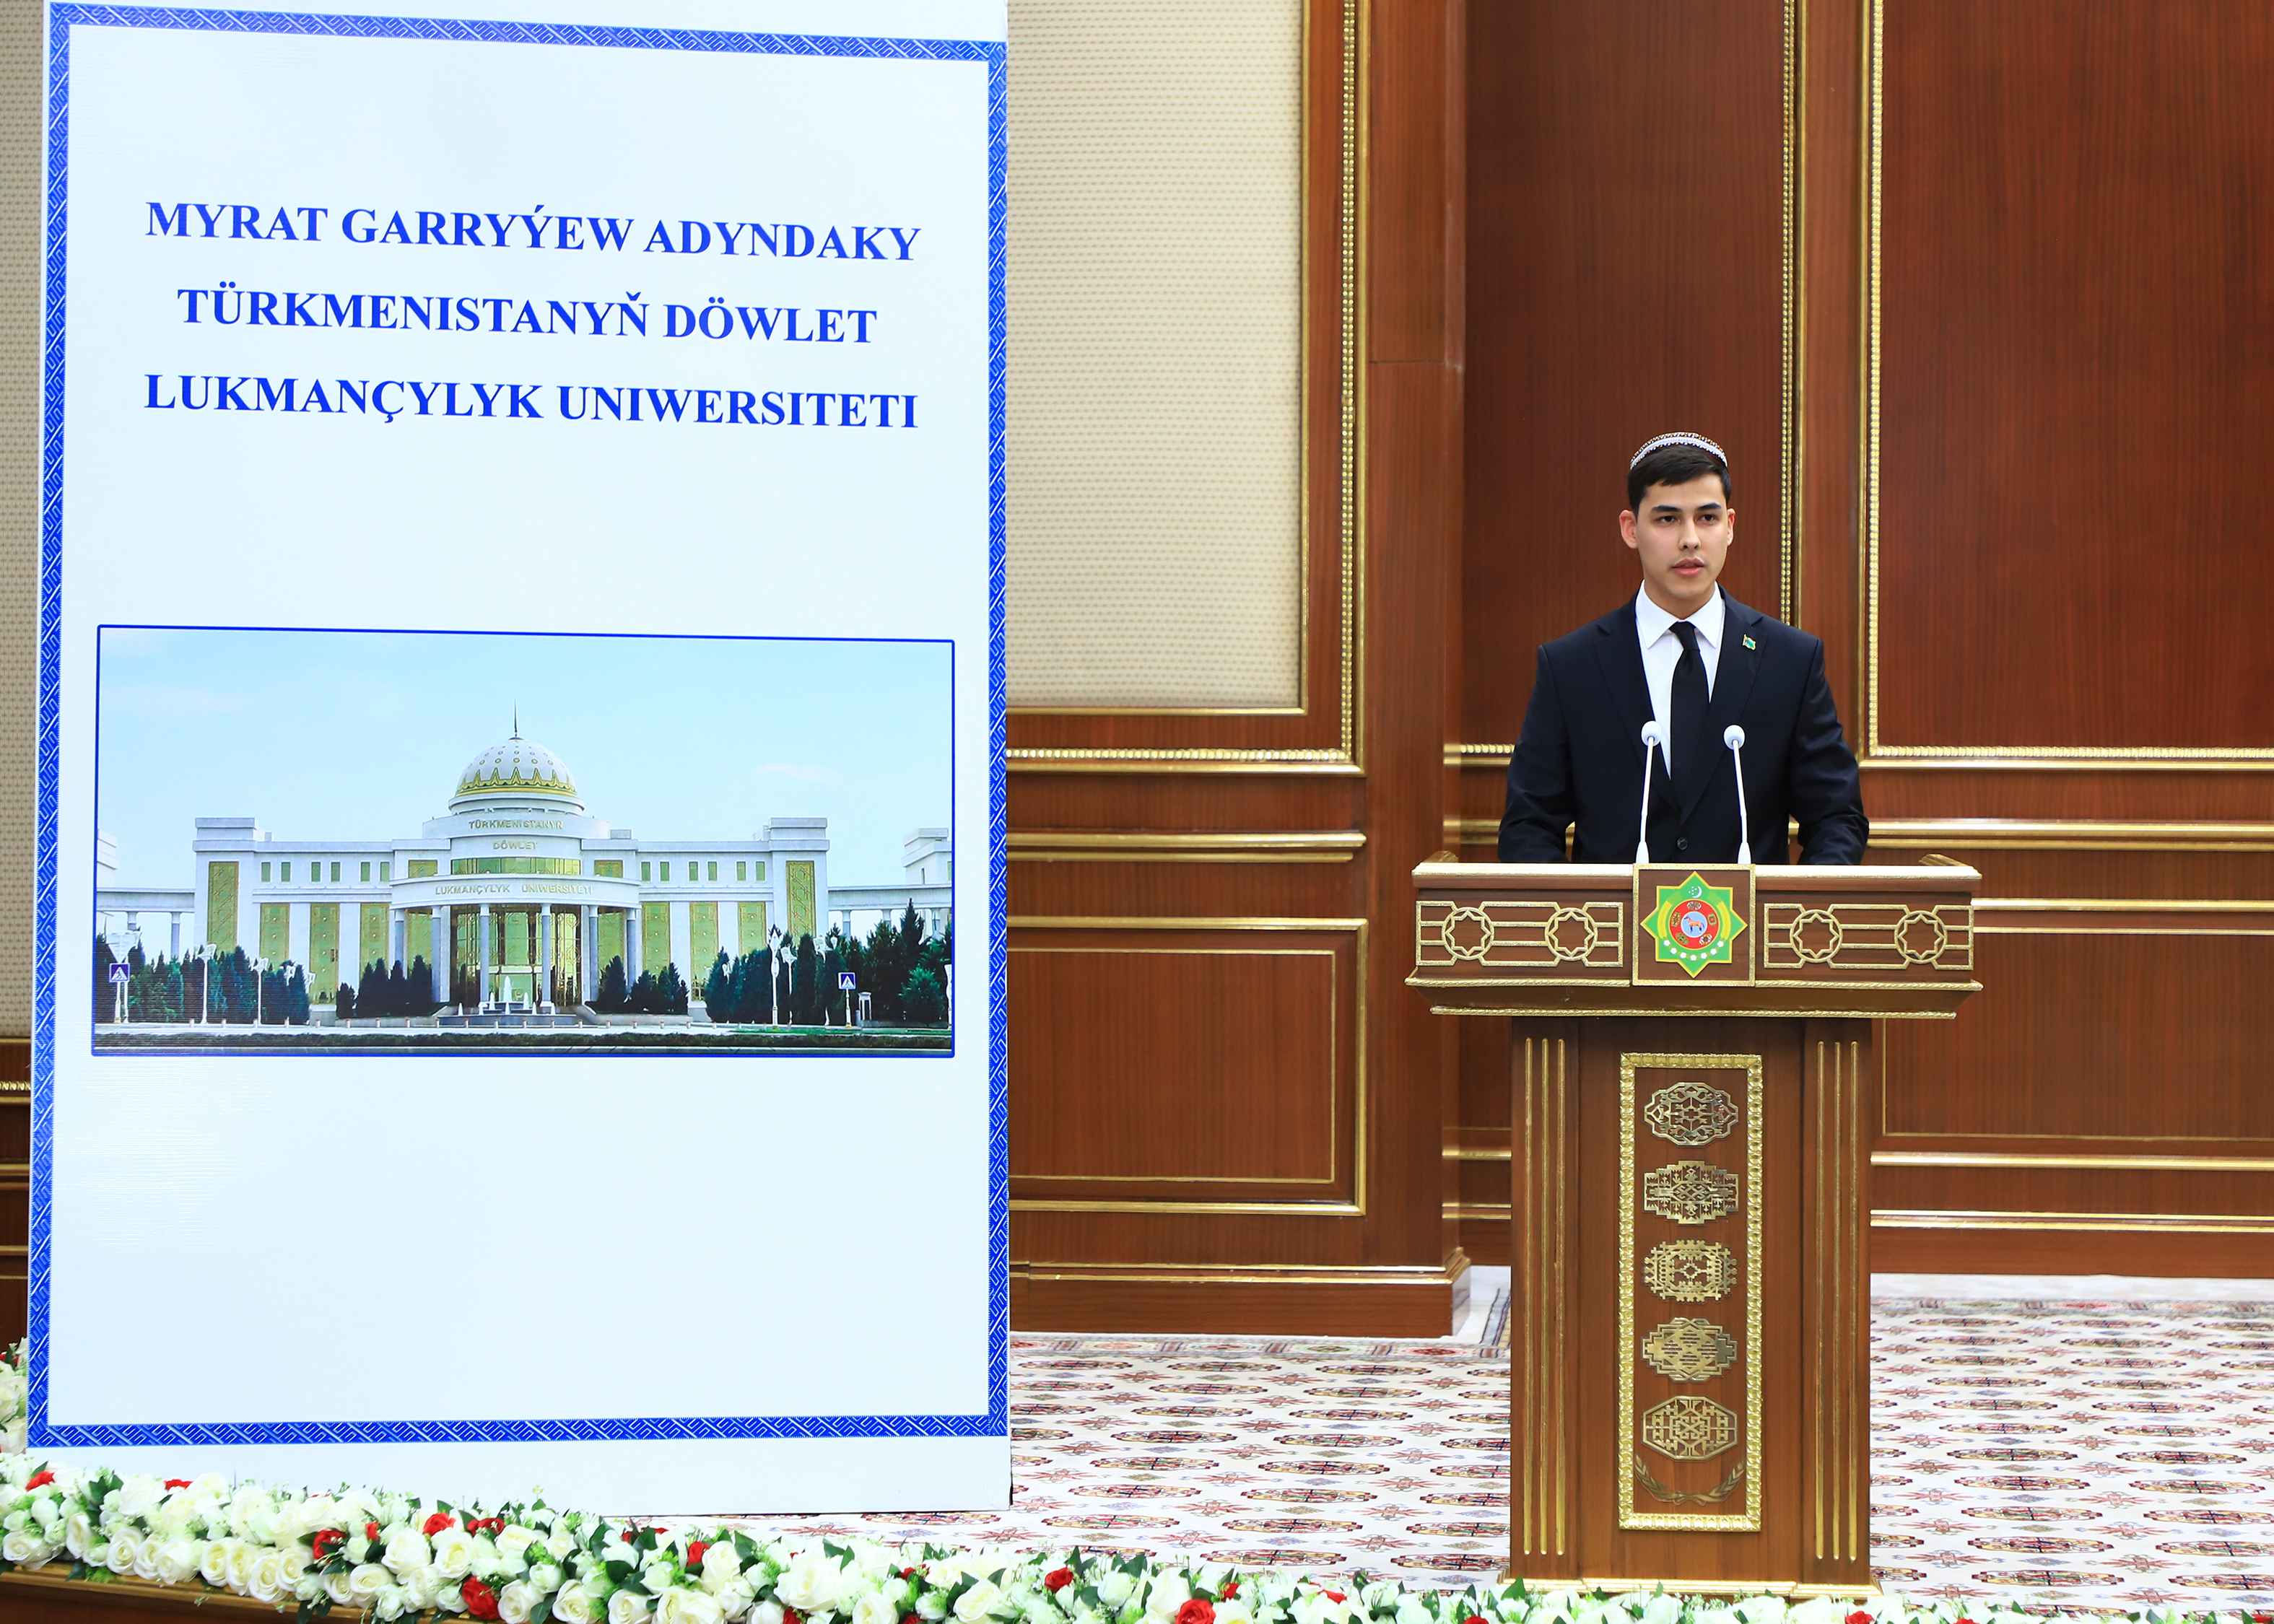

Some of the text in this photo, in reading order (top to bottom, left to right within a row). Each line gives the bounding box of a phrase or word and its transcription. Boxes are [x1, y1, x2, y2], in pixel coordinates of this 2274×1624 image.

[144, 201, 921, 261] MYRAT GARRYÝEW ADYNDAKY
[177, 280, 878, 344] TÜRKMENISTANYŇ DÖWLET
[144, 374, 918, 428] LUKMANÇYLYK UNIWERSITETI
